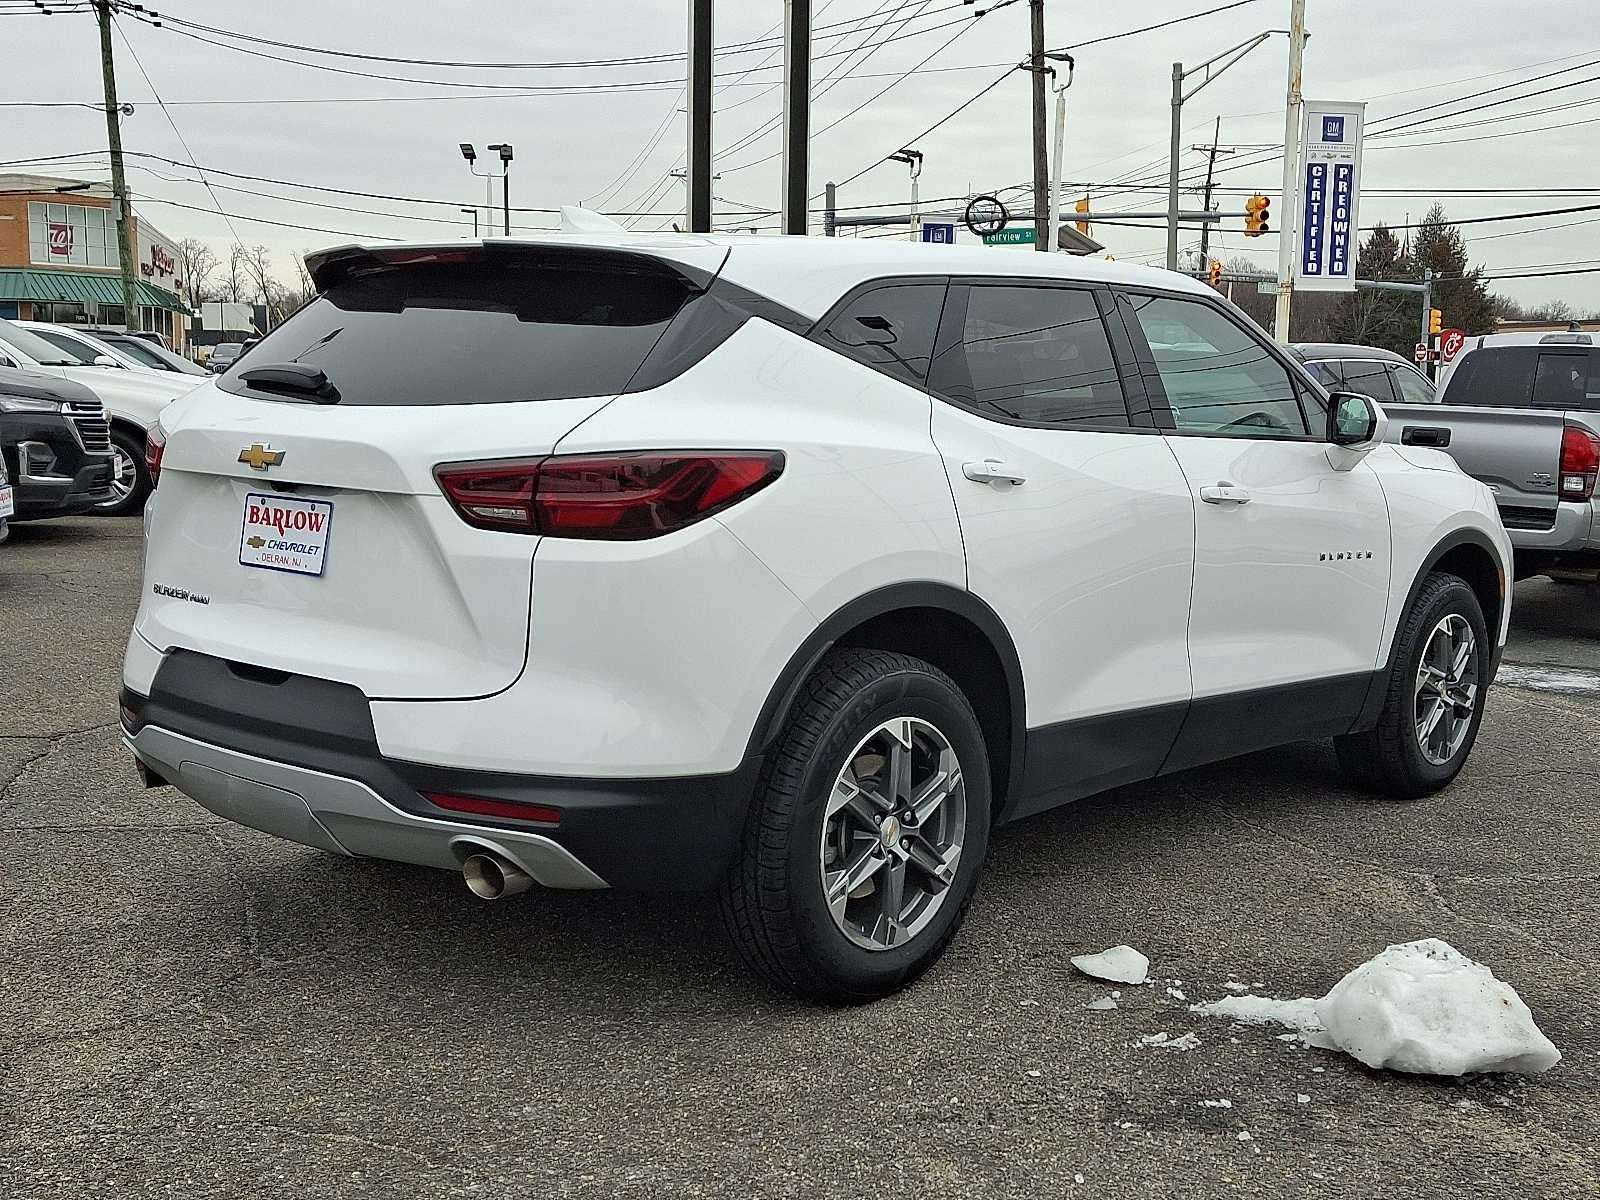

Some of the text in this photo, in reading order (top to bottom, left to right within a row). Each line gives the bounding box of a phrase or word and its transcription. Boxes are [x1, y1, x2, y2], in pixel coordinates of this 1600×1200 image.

[1327, 121, 1339, 133] GM
[1307, 166, 1322, 273] CERTIFIED
[1333, 167, 1348, 273] PREOWNED
[248, 505, 326, 537] BARLOW
[267, 539, 320, 556] CHEVROLET
[291, 557, 301, 567] NJ
